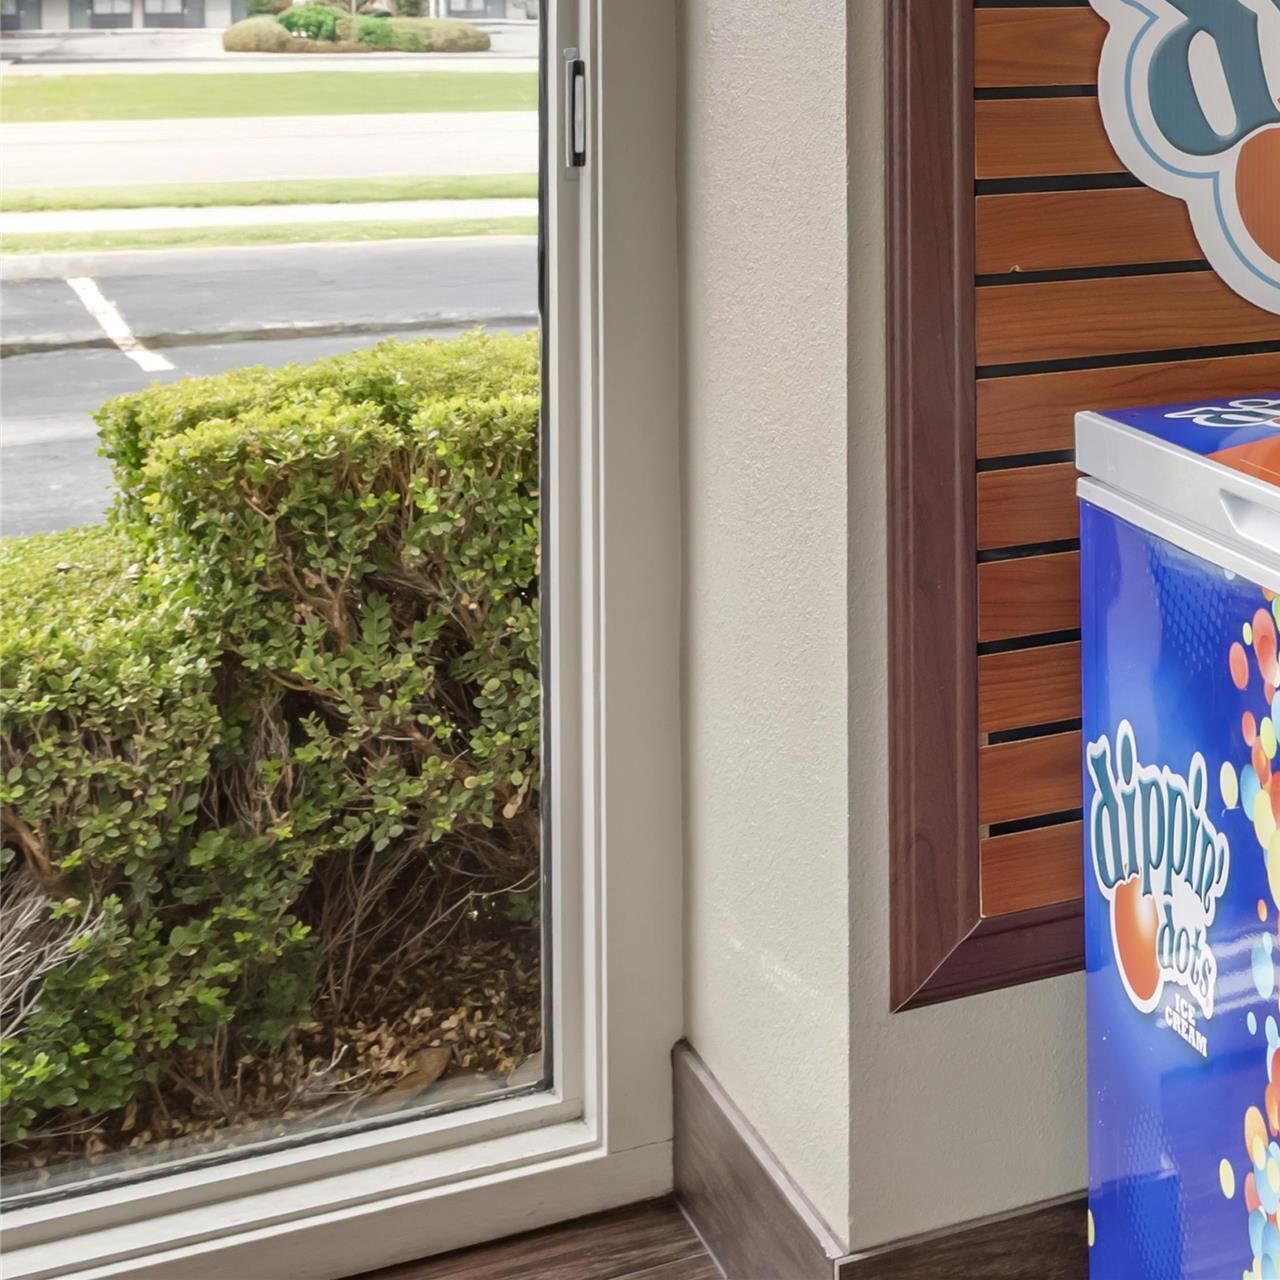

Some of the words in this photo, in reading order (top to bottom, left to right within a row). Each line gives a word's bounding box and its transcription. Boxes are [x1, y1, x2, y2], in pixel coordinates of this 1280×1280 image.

[1158, 901, 1213, 998] dots
[1164, 1004, 1208, 1058] CREAM
[1174, 992, 1197, 1019] ICE
